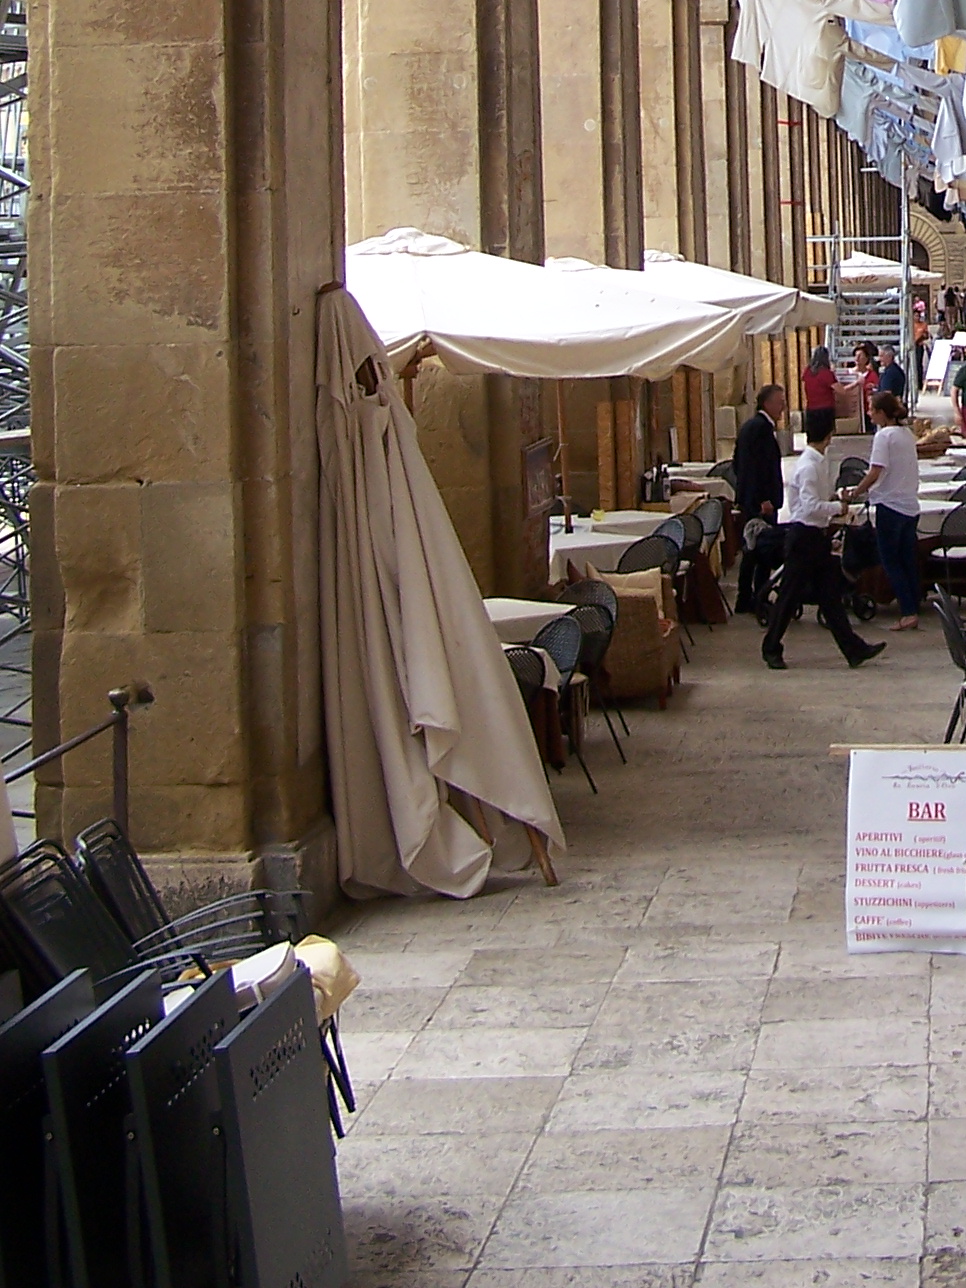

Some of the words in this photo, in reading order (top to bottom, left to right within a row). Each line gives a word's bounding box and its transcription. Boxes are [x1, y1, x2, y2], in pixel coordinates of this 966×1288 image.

[908, 801, 947, 820] BAR
[855, 832, 903, 842] APERITIVI
[855, 847, 879, 857] VINO
[880, 848, 892, 857] AL
[894, 848, 943, 858] BICCHIERE
[855, 863, 893, 873] FRUTTA
[894, 864, 929, 874] FRESCA
[855, 878, 895, 888] DESSERT
[854, 897, 912, 907] STUZZICHINI
